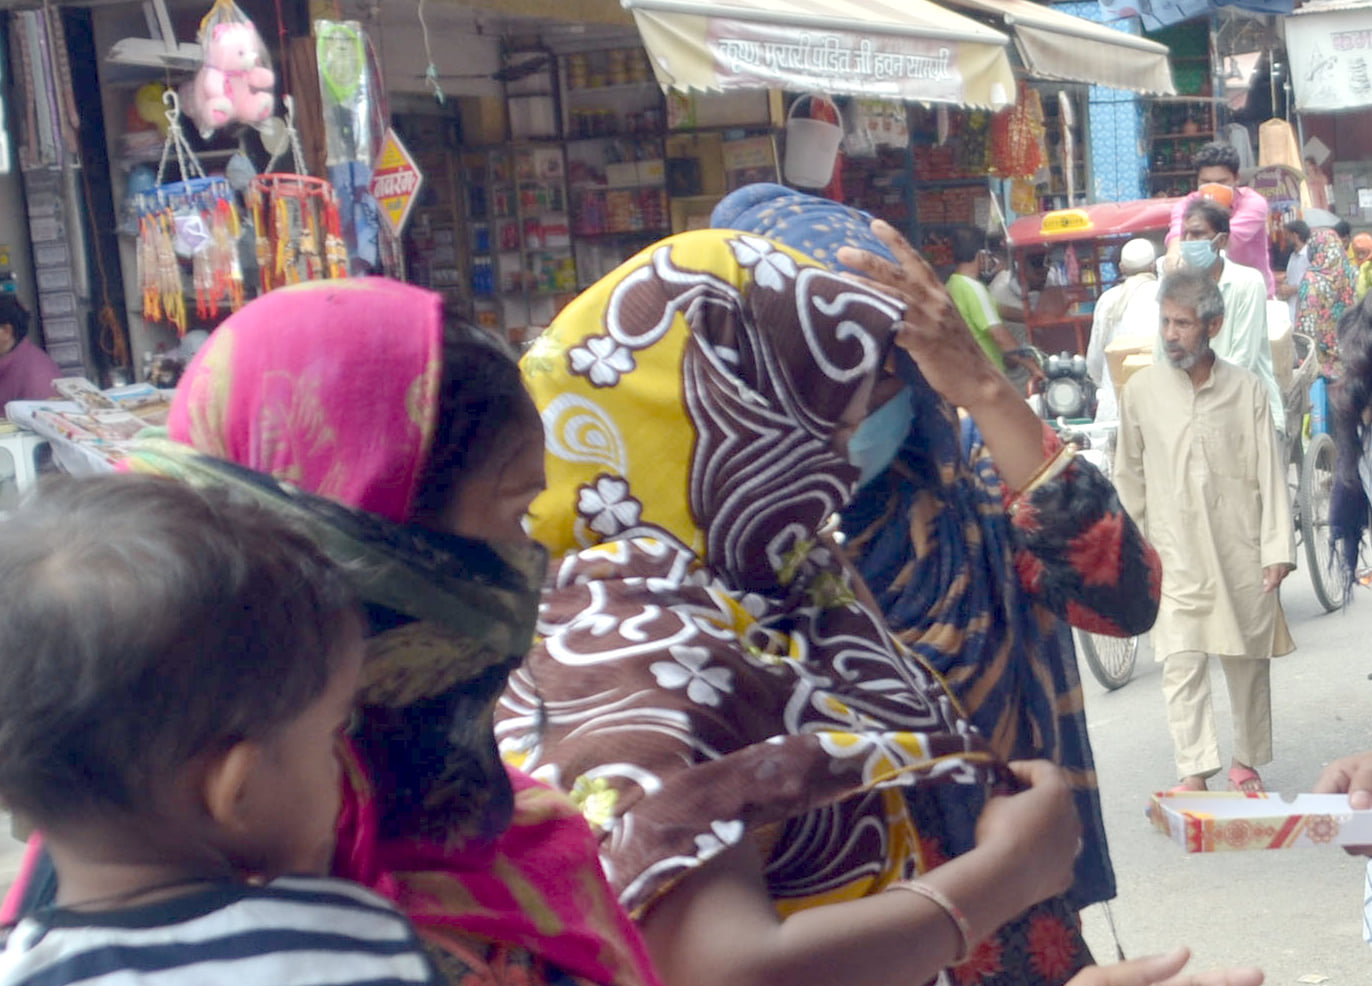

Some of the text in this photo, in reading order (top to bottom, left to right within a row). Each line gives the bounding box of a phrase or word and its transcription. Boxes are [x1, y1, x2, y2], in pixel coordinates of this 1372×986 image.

[763, 33, 811, 74] मुरारी
[853, 38, 872, 75] जी
[873, 51, 905, 79] हवन
